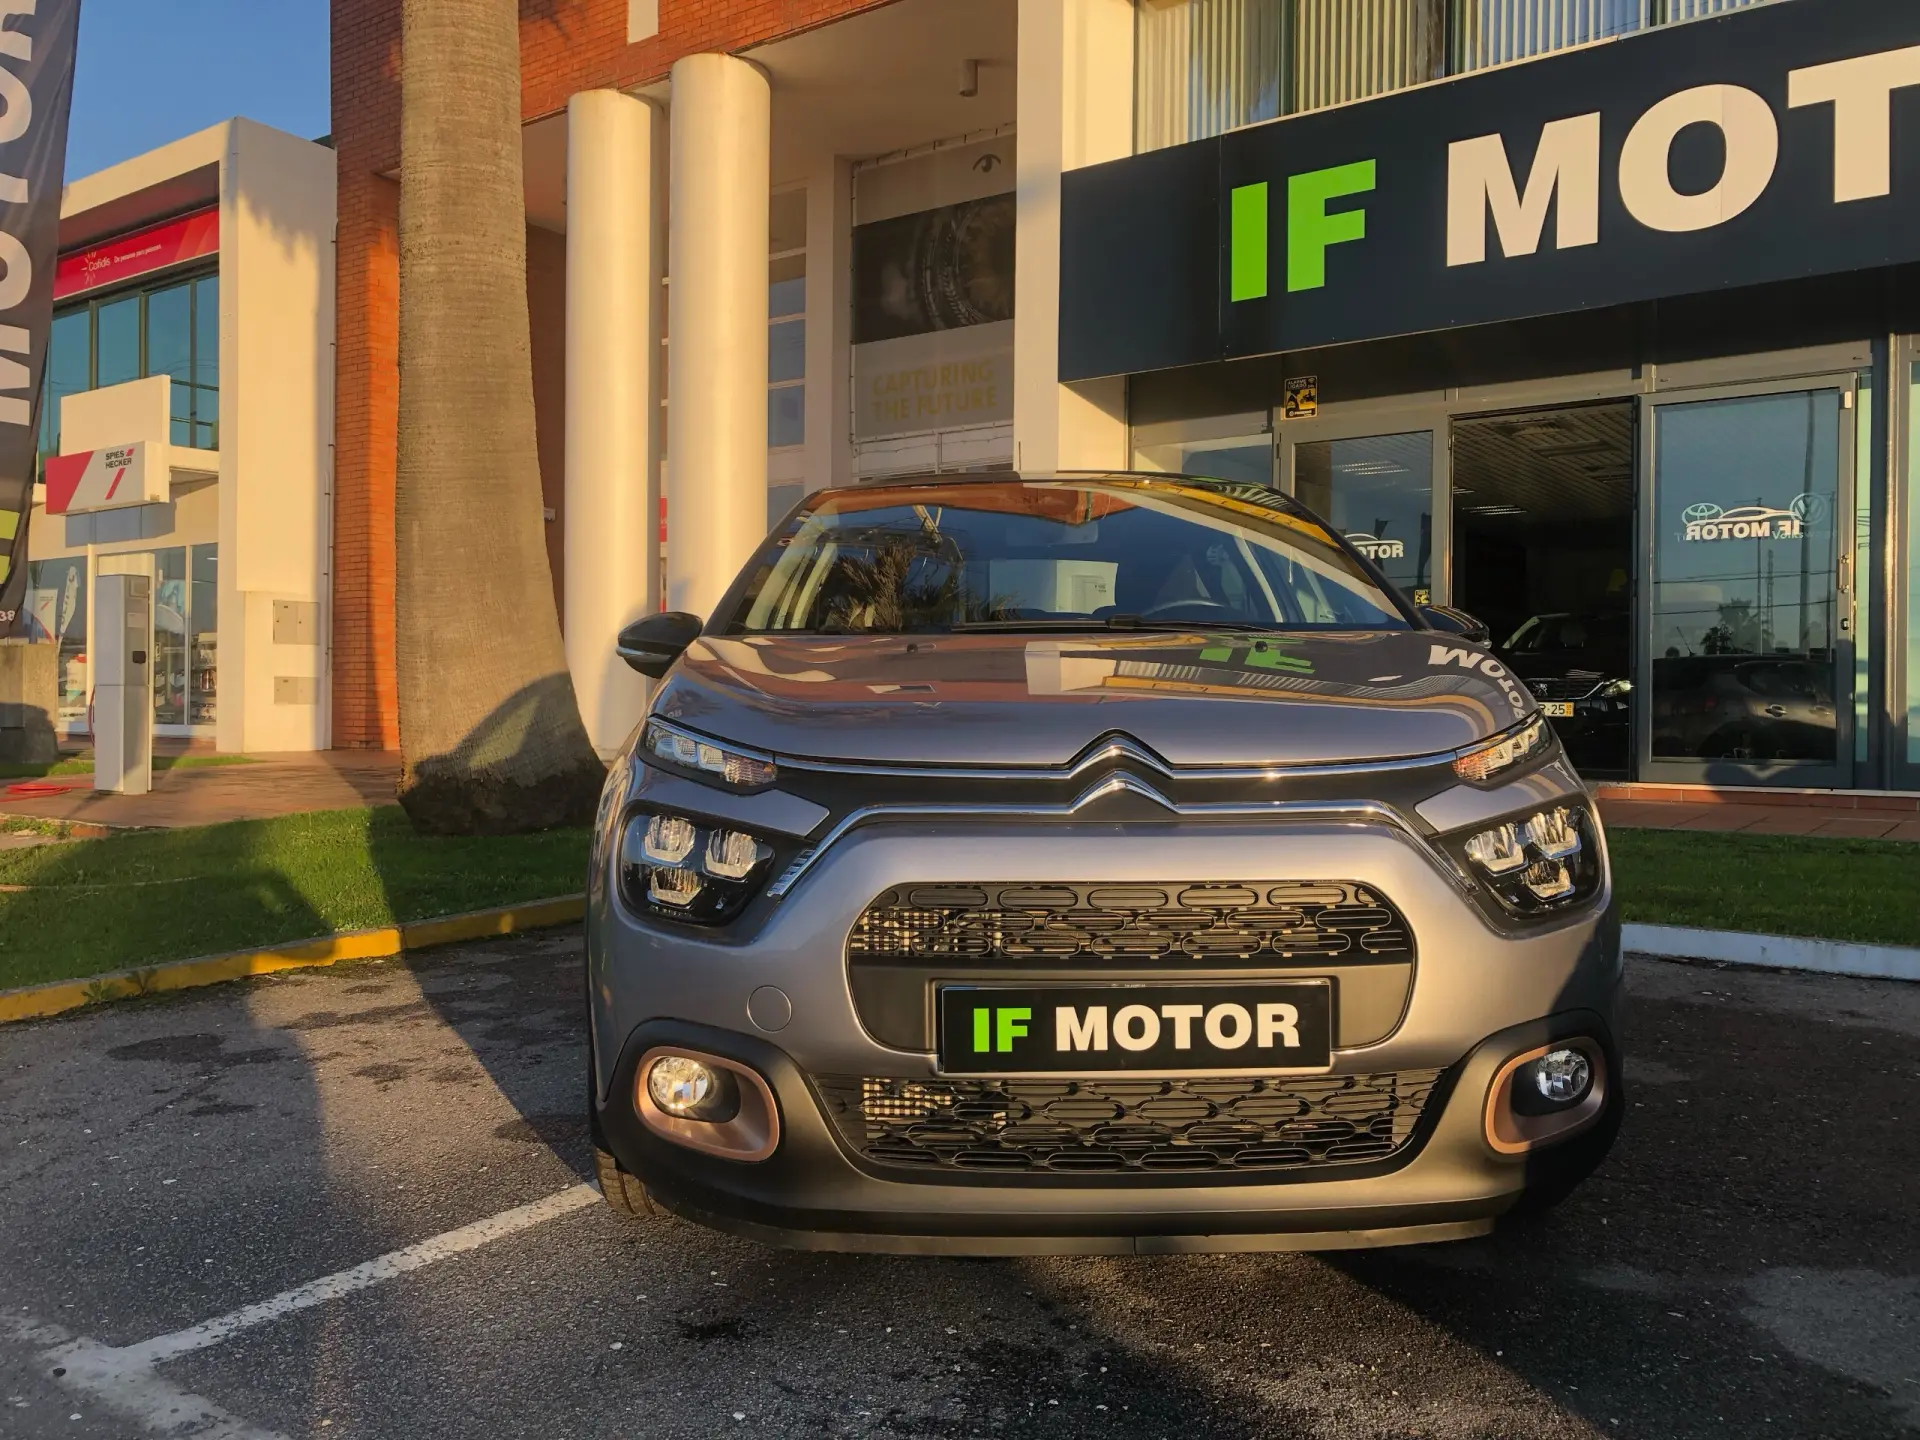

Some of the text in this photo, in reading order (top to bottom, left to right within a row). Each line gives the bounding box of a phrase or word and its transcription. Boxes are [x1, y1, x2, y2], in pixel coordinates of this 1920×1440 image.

[1231, 45, 1920, 302] IF MOT
[88, 256, 111, 272] Cofidis
[872, 358, 994, 396] CAPTURING
[872, 386, 997, 421] THE FUTURE
[105, 450, 125, 461] SPIES
[105, 457, 132, 469] HECKER
[973, 1003, 1301, 1053] IF MOTOR
